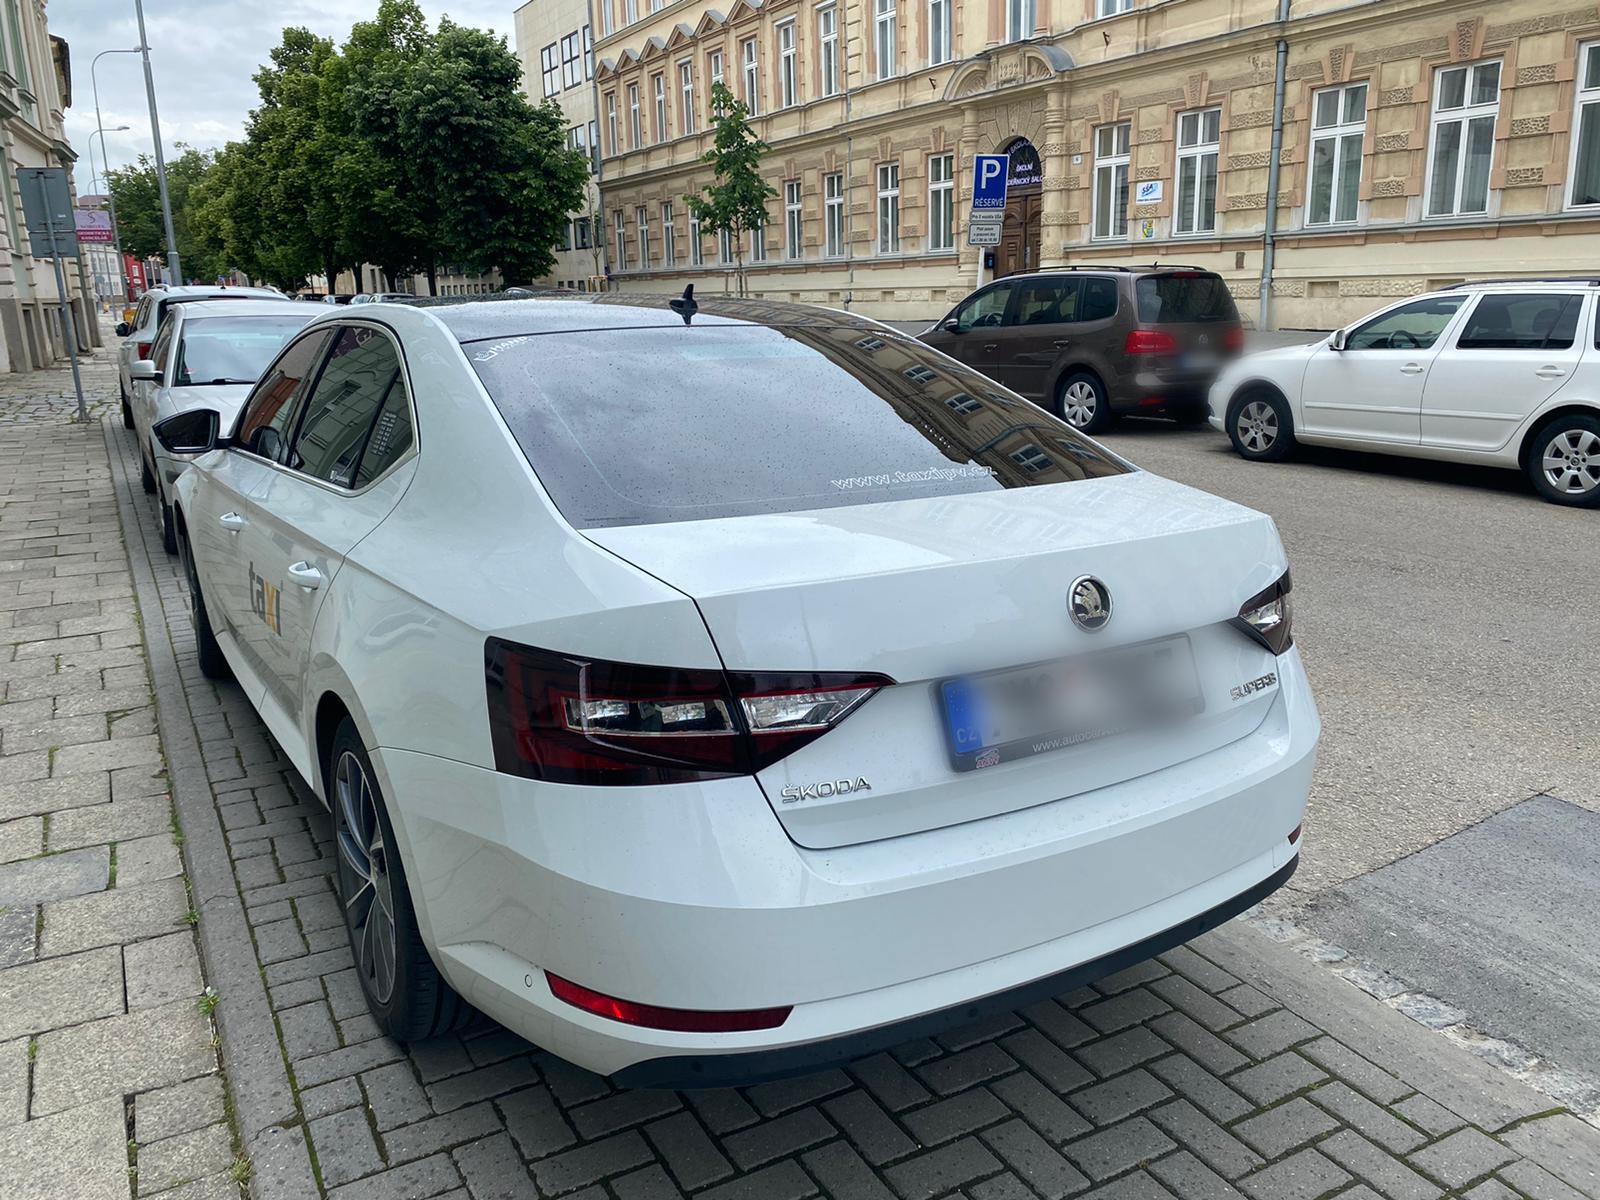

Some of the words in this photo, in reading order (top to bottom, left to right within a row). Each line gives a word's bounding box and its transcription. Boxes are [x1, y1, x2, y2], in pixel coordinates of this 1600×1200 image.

[981, 159, 1001, 189] P
[248, 560, 284, 637] taxi
[1229, 672, 1277, 702] SUPERB
[781, 776, 872, 804] ŠKODA
